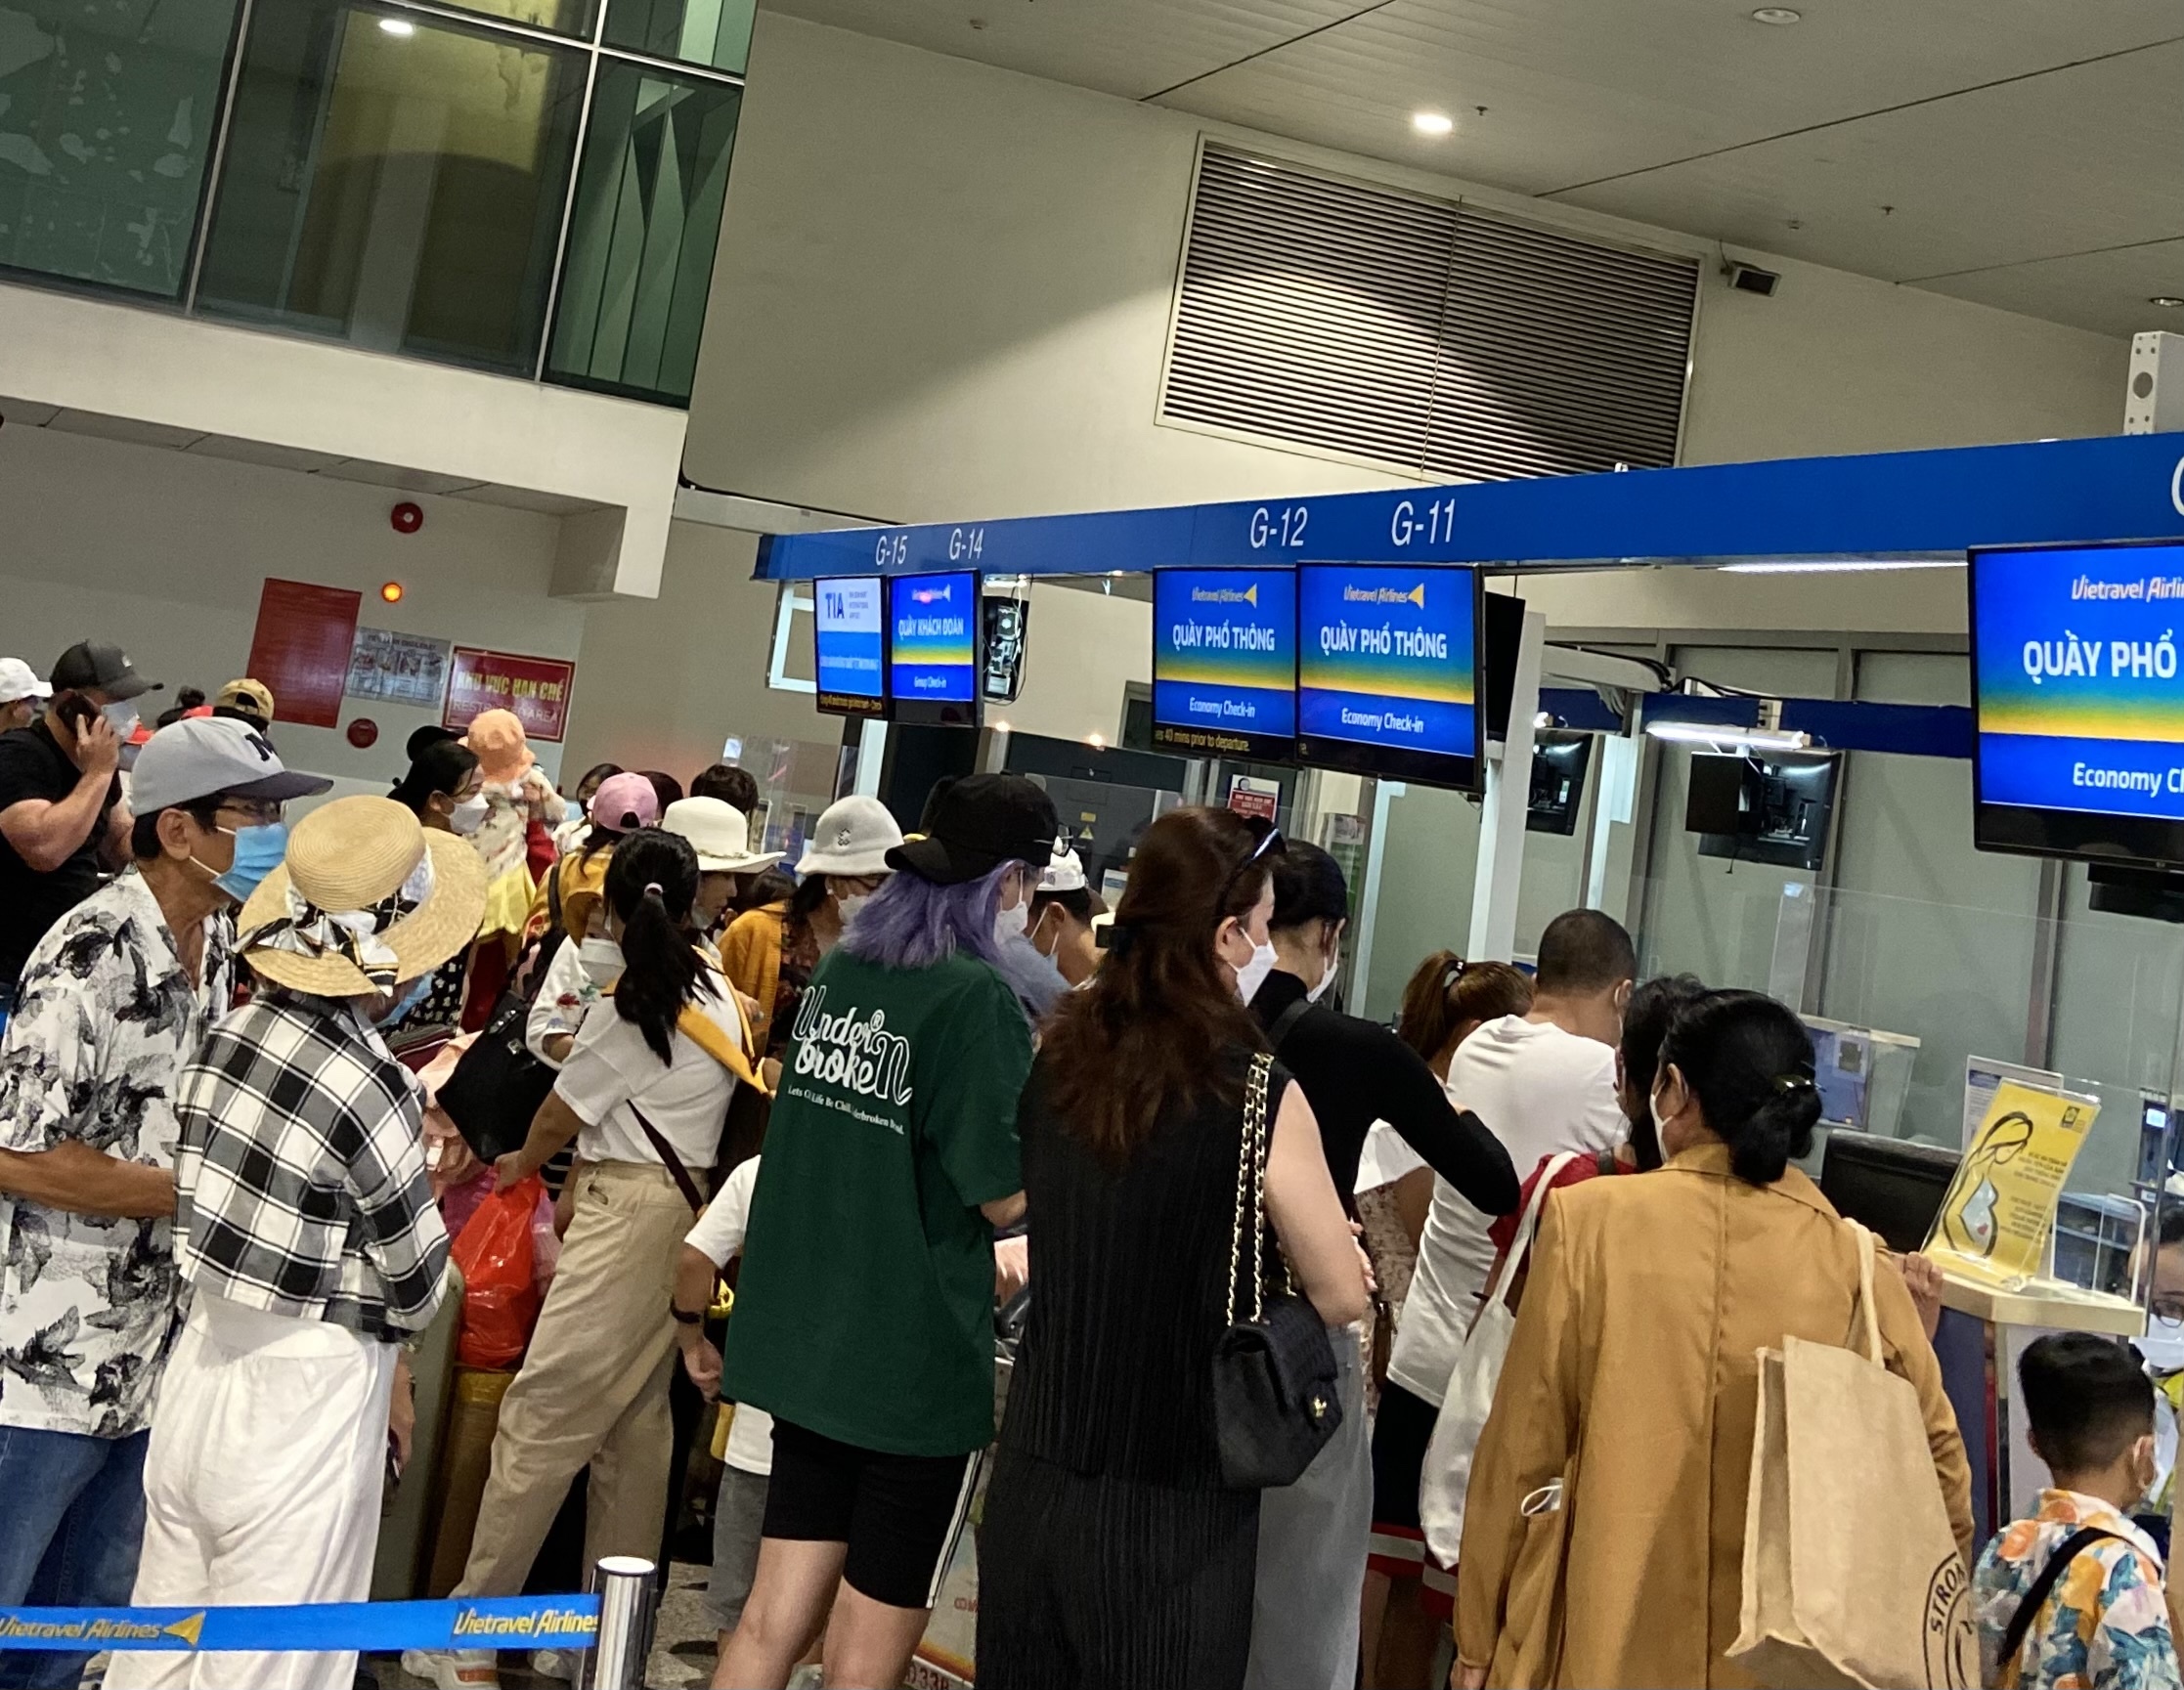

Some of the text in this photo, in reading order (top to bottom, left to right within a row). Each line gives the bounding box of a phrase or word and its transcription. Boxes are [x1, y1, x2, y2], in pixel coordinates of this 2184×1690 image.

[1250, 506, 1308, 549] G-12
[1391, 498, 1457, 547] G-11
[876, 536, 908, 566] G-15
[949, 528, 984, 560] G-14
[1344, 584, 1408, 605] Vietravel Airlines
[2071, 574, 2144, 601] Vietravel
[825, 592, 845, 620] TIA
[1172, 619, 1275, 652] QUẦY PHỔ THÔNG
[1321, 620, 1448, 659] QUẦY PHỔ THÔNG
[2023, 628, 2177, 684] QUẦY PHỔ
[1190, 697, 1255, 718] Economy Check-in
[1341, 708, 1423, 733] Economy Check-in
[2073, 761, 2162, 799] Economy
[83, 1618, 161, 1642] Airlines
[455, 1607, 536, 1635] Vietravel
